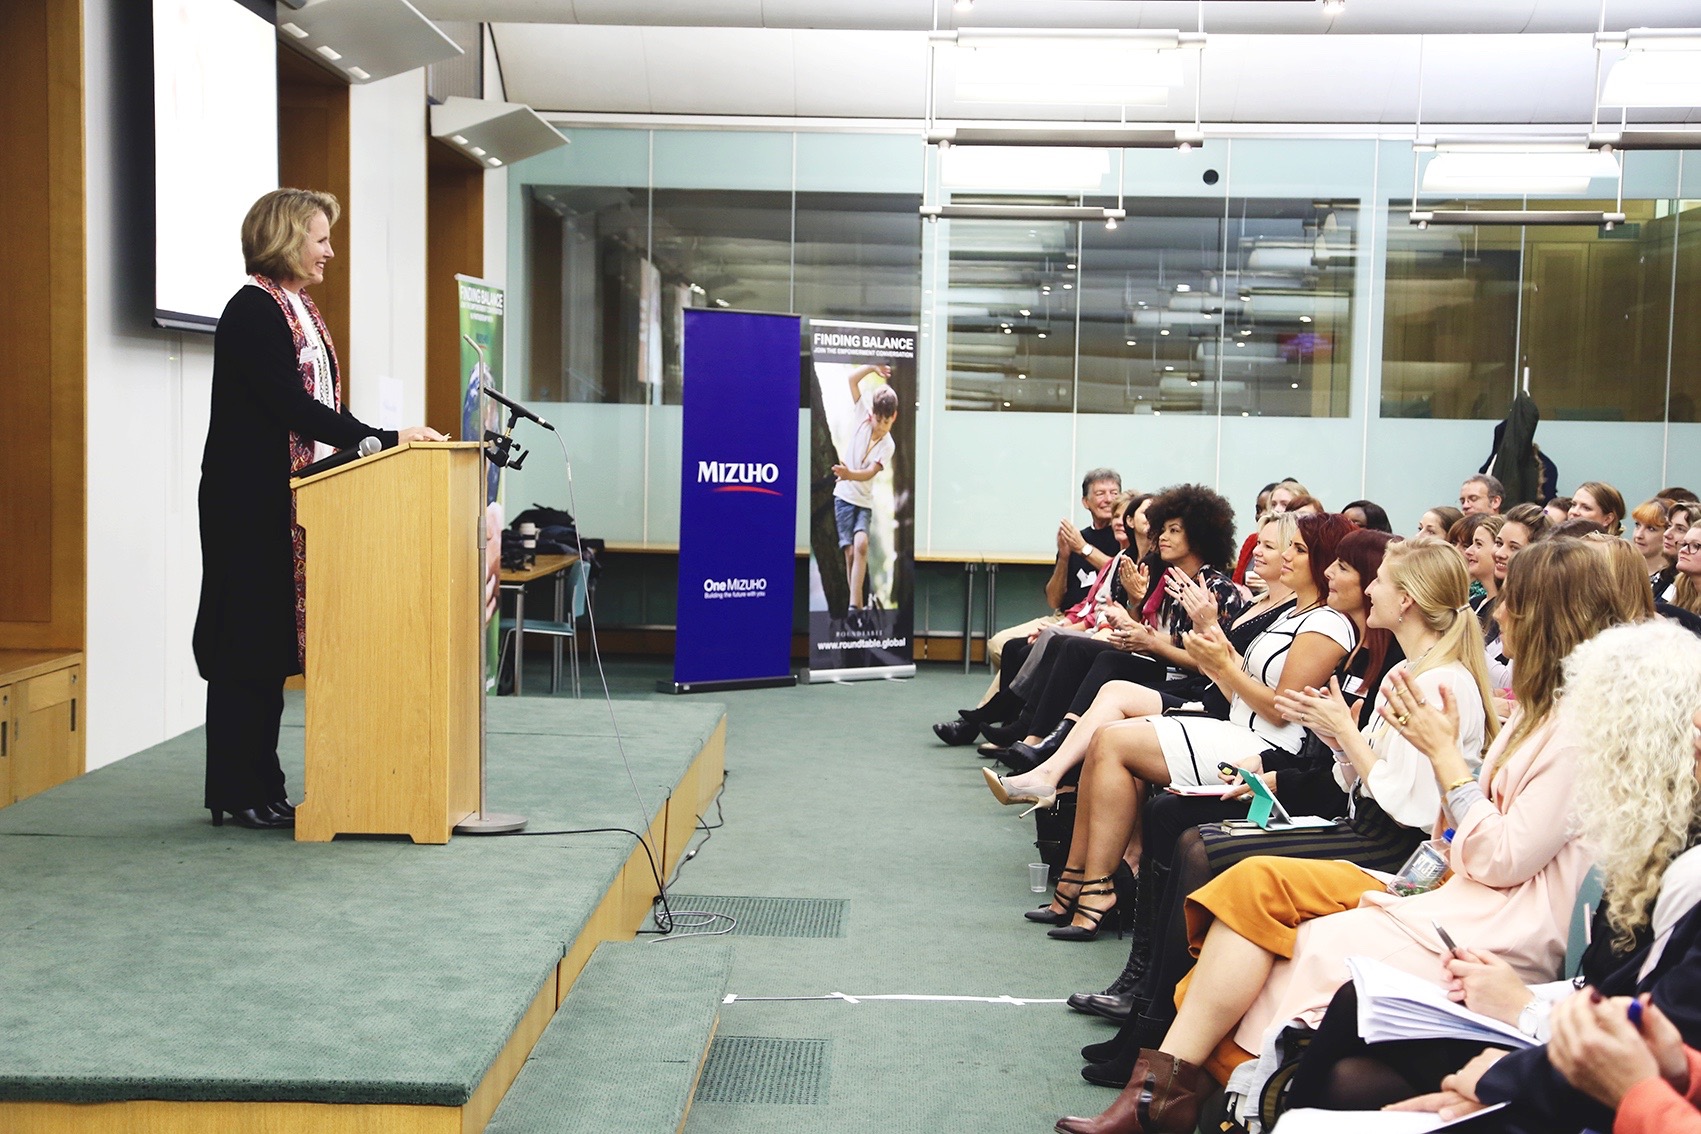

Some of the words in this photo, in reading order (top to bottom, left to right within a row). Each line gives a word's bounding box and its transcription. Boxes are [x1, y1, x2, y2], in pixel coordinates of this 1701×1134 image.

[813, 332, 861, 347] FINDING
[862, 335, 914, 350] BALANCE
[826, 347, 837, 355] THE
[837, 348, 876, 356] EMPOWERMENT
[876, 350, 914, 358] CONVERSATION
[697, 460, 780, 484] MIZUHO
[704, 592, 723, 600] Building
[817, 637, 906, 650] www.roundtable.global
